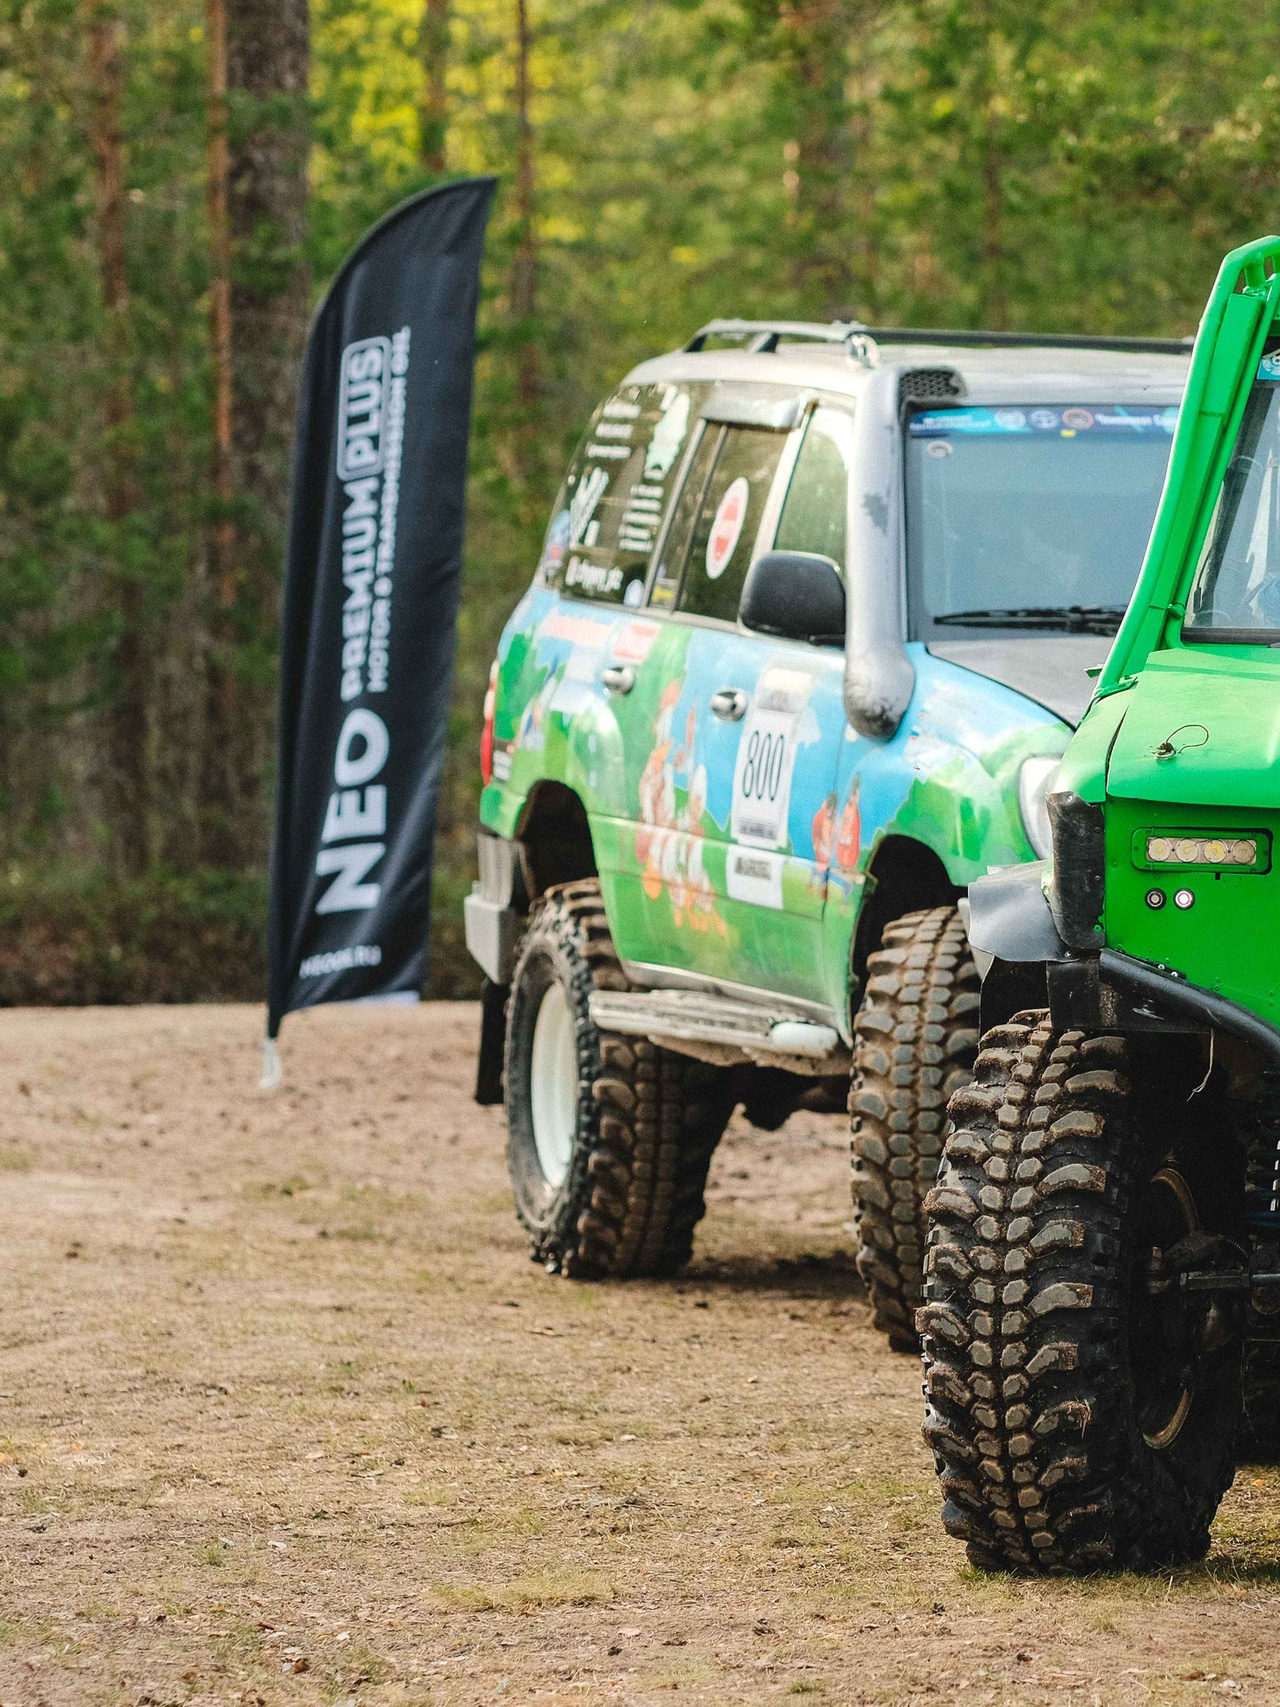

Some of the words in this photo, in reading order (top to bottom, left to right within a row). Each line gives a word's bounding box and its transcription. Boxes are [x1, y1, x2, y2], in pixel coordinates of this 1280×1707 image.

[344, 345, 385, 470] PLUS
[367, 599, 391, 694] MOTOR
[391, 326, 411, 376] OIL
[340, 477, 380, 702] PREMIUM
[314, 707, 390, 915] NEO
[741, 730, 786, 802] 800
